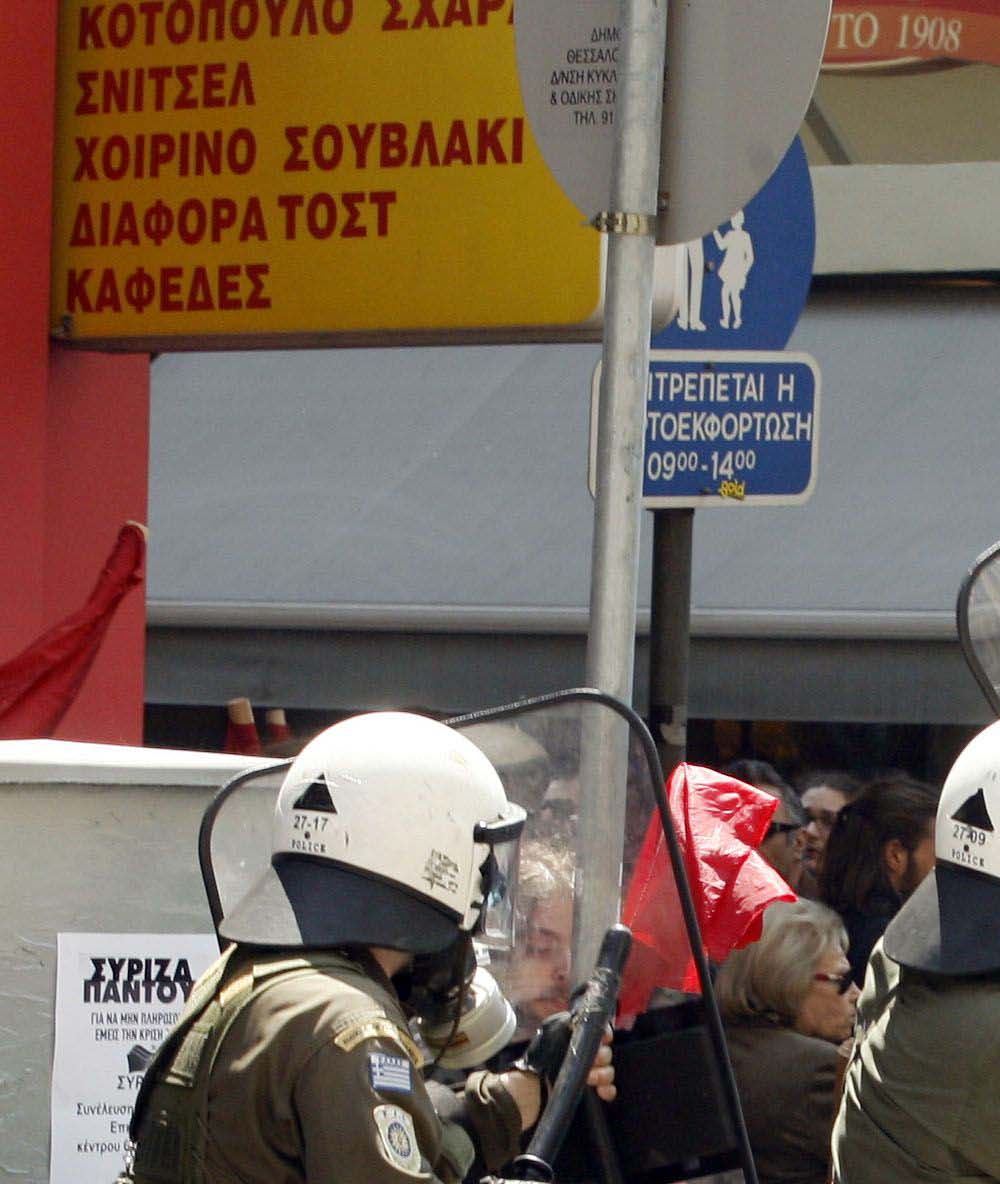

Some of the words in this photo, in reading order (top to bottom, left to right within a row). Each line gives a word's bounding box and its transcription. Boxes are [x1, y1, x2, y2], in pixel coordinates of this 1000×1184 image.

[77, 0, 353, 51] ΚΟΤΟΠΟΥΛΟ
[381, 0, 514, 31] ΣΧΑΡ
[898, 14, 962, 51] 1908
[75, 62, 256, 116] ΣΝΙΤΣΕΛ
[550, 90, 558, 106] &
[560, 89, 602, 106] ΟΔΙΚΗΣ
[73, 128, 257, 182] ΧΟΙΡΙΝΟ
[283, 117, 524, 173] ΣΟΥΒΛΑΚΙ
[69, 196, 268, 248] ΔΙΑΦΟΡΑ
[277, 191, 397, 241] ΤΟΣΤ
[66, 264, 272, 314] ΚΑΦΕΔΕΣ
[778, 374, 795, 402] Η
[293, 814, 329, 832] 27-17
[291, 839, 326, 853] POLICE
[951, 848, 985, 867] POLICE
[90, 957, 193, 982] ΣΥΡΙΖΑ
[83, 980, 195, 1003] ΠΑΝΤΟΥ
[91, 1012, 104, 1025] ΓΙΑ
[106, 1012, 119, 1025] ΝΑ
[120, 1012, 139, 1025] ΜΗΝ
[141, 1012, 180, 1025] ΠΛΗΡΩΣΟ
[95, 1028, 119, 1041] ΕΜΕΙΣ
[121, 1028, 137, 1041] ΤΗΝ
[139, 1028, 164, 1041] ΚΡΙΣΗ
[76, 1102, 135, 1116] Συνέλευση
[77, 1140, 121, 1156] κέντρου
